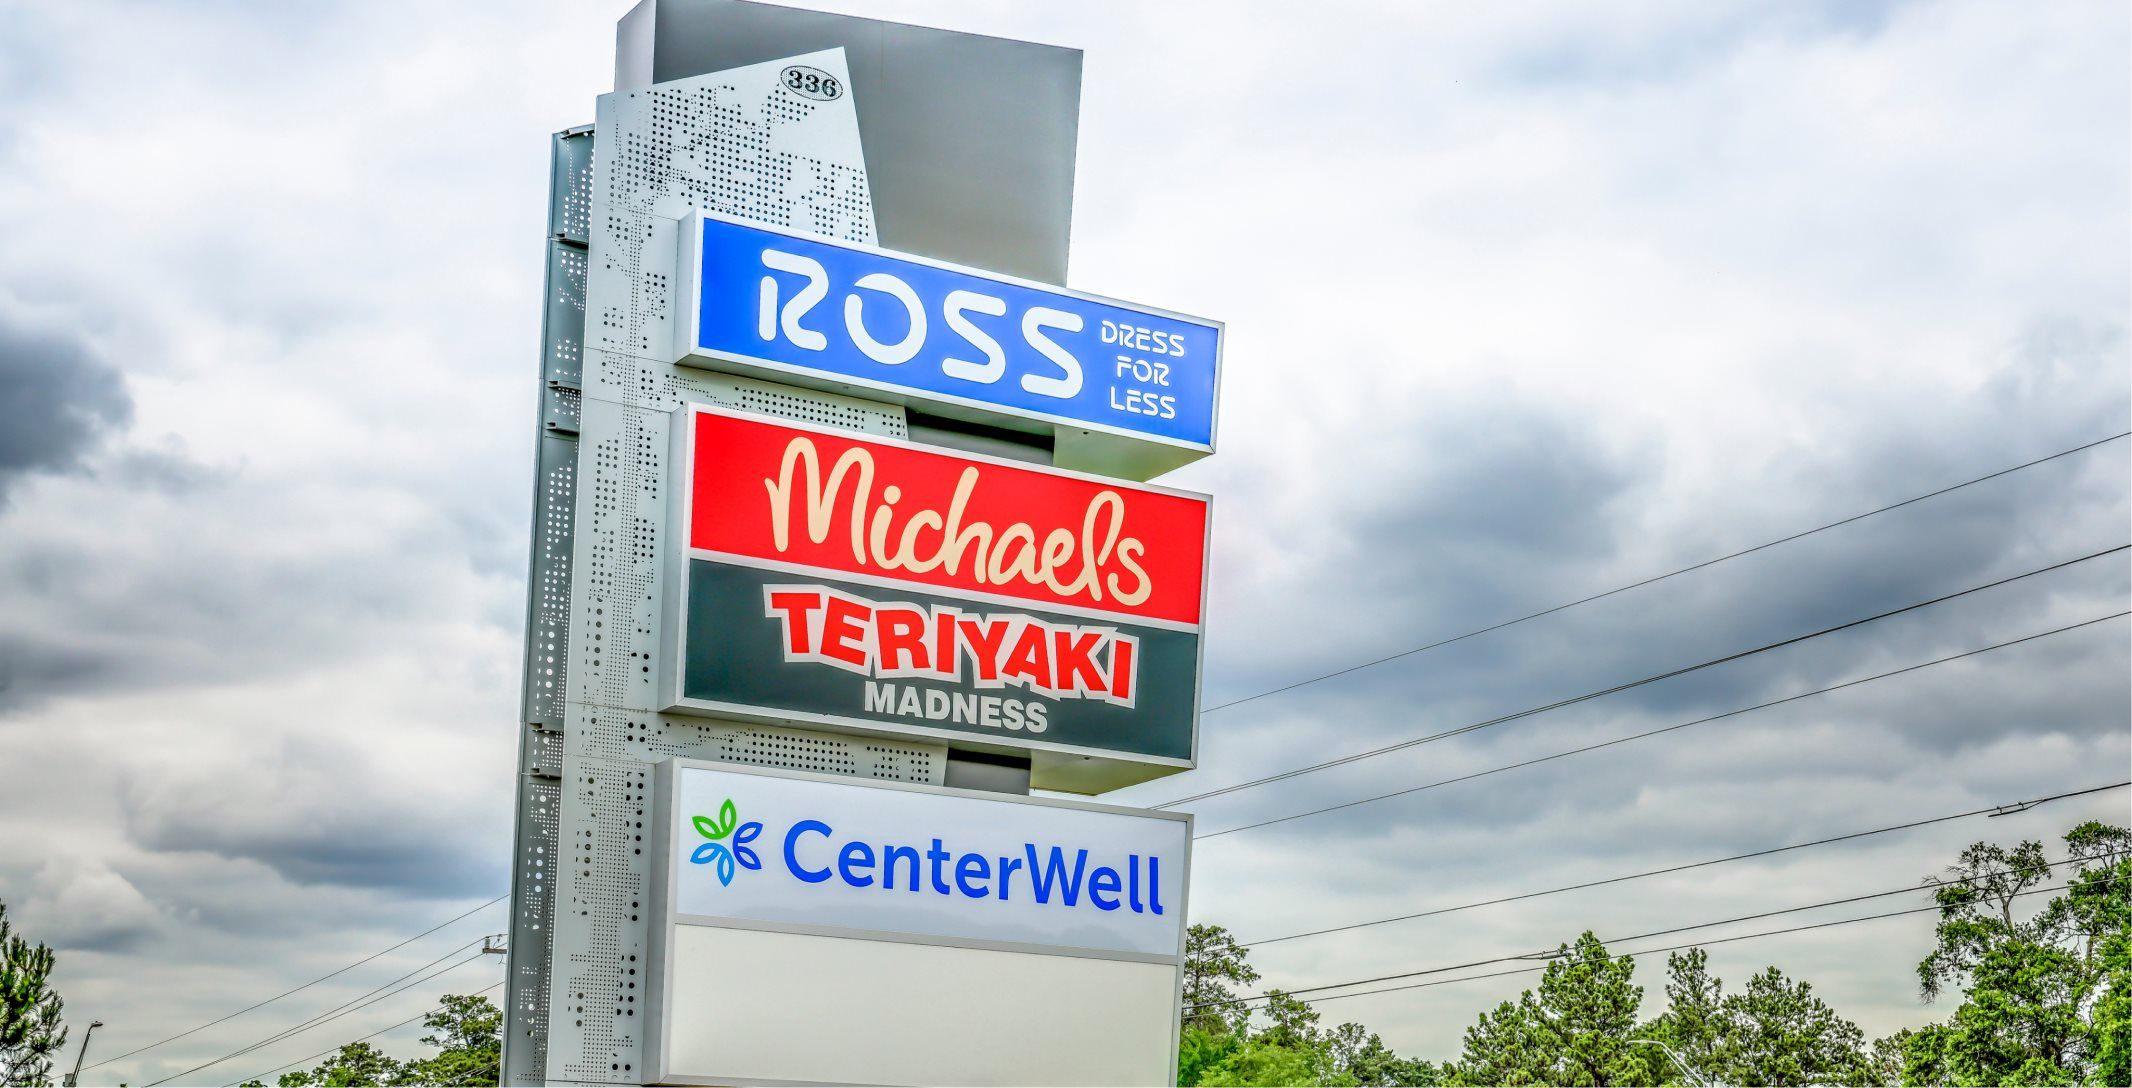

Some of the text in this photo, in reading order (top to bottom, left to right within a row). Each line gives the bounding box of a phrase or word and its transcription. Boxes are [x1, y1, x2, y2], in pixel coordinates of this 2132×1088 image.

[788, 70, 837, 98] 336
[758, 248, 1084, 399] ROSS
[1101, 319, 1185, 358] DRESS
[1117, 356, 1170, 387] FOR
[1110, 386, 1176, 420] LESS
[764, 437, 1152, 606] Michaels
[768, 588, 1136, 704] TERIYAKI
[864, 681, 1049, 733] MADNESS
[783, 819, 1164, 915] CenterWell
